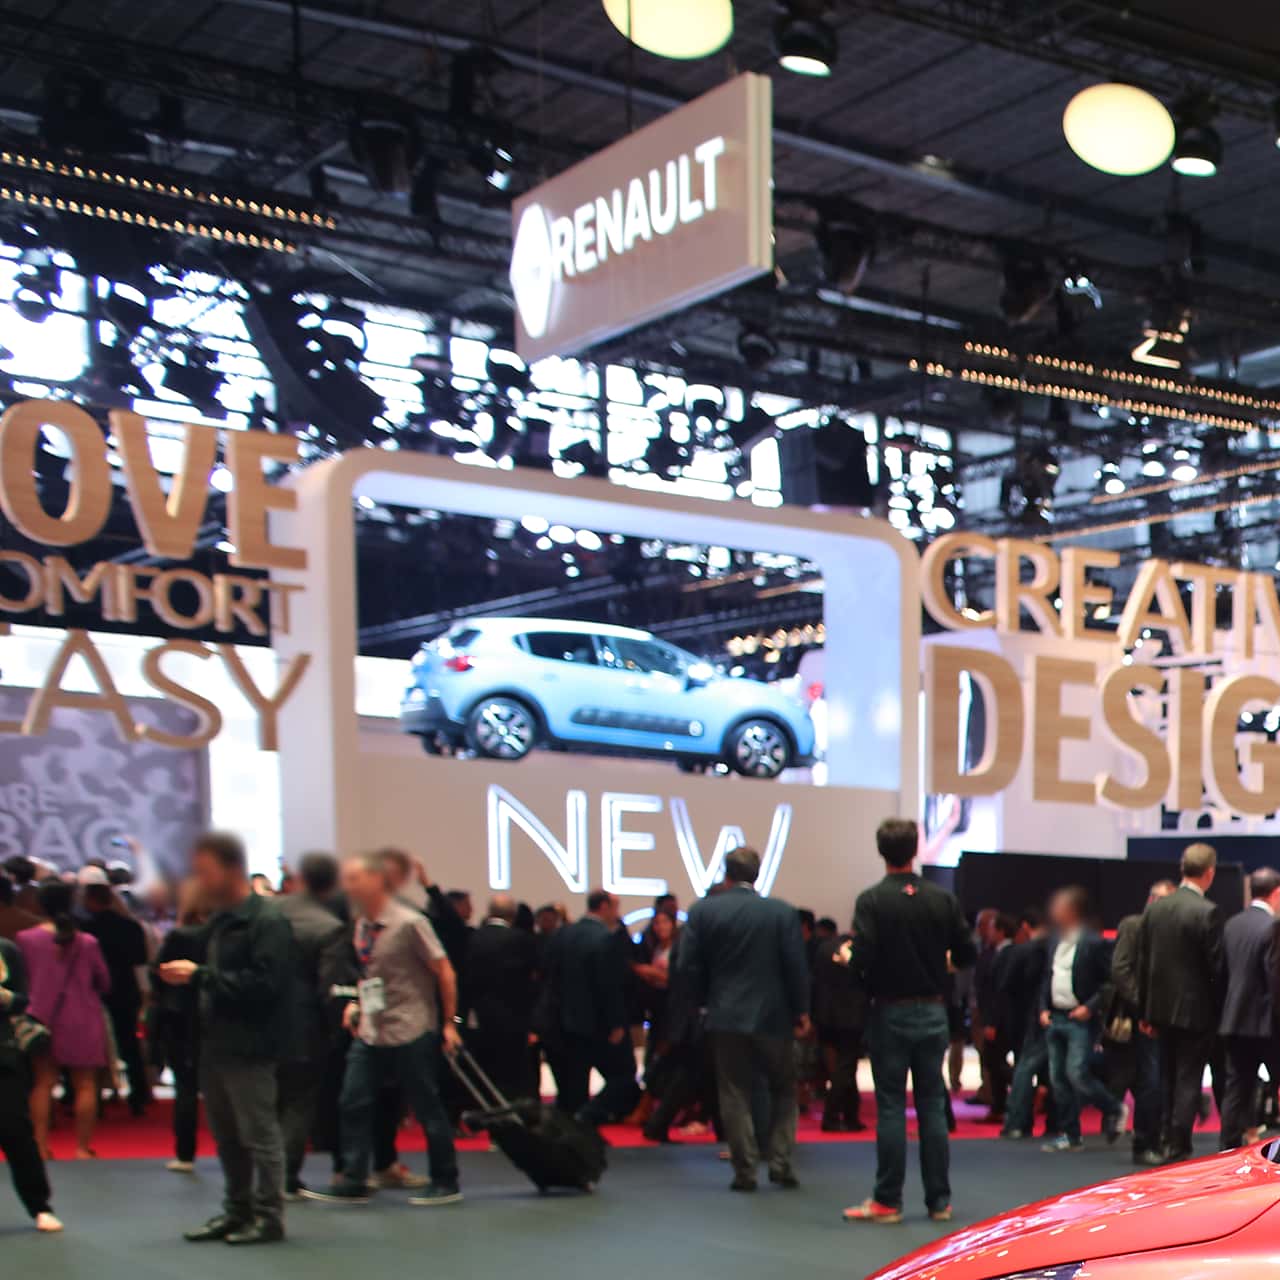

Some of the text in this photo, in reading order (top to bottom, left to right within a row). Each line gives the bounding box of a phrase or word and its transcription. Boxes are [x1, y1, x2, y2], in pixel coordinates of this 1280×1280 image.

[551, 136, 725, 280] RENAULT
[0, 621, 312, 752] ASY
[487, 783, 793, 898] NEW
